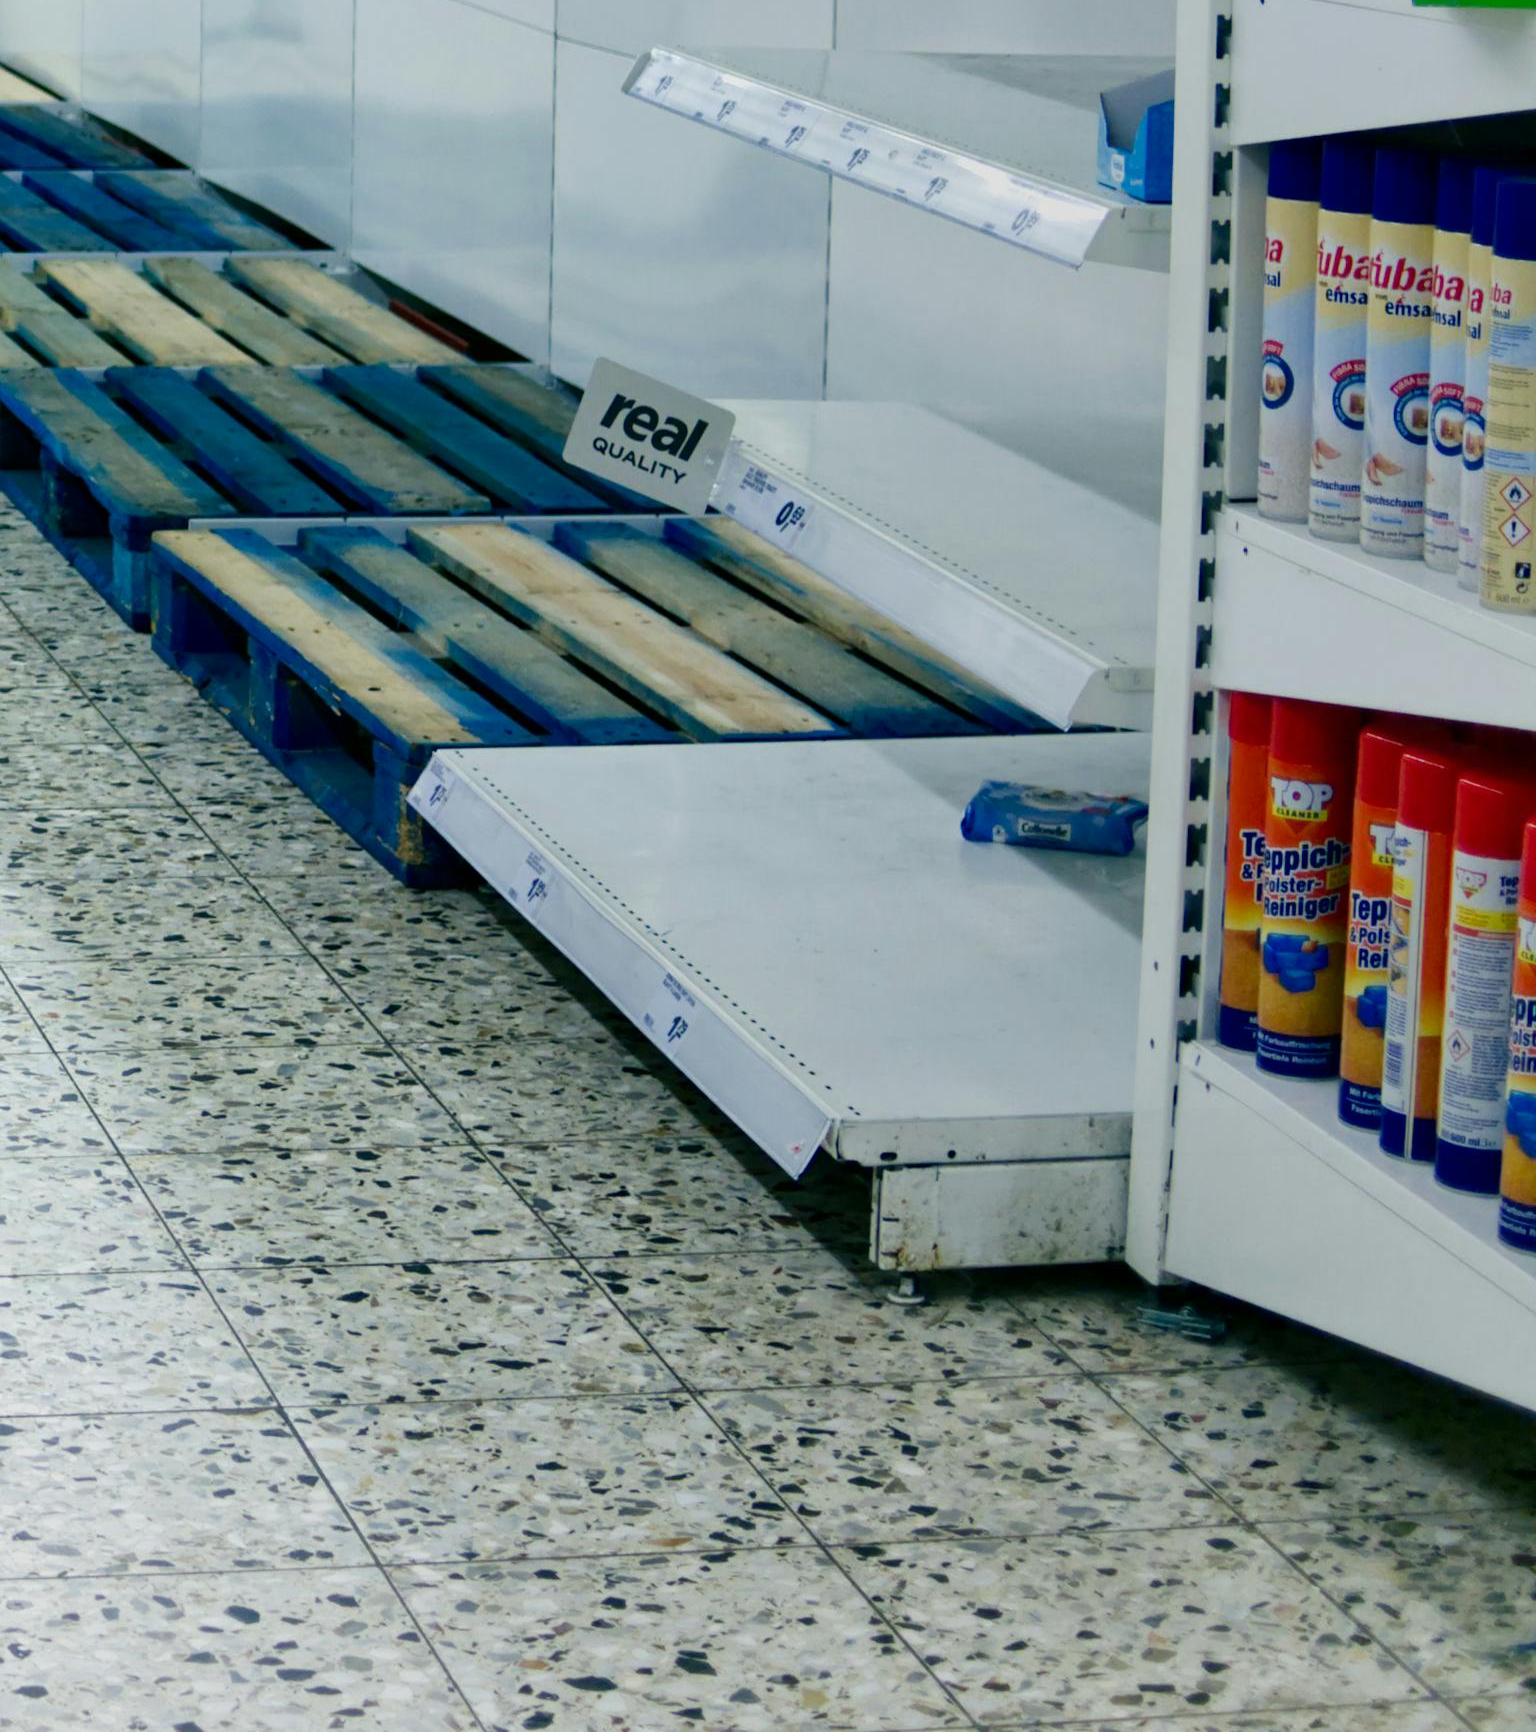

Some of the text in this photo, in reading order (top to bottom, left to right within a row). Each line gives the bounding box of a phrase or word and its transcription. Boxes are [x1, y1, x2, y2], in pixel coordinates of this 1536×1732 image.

[600, 393, 709, 462] real
[592, 436, 687, 485] QUALITY
[1271, 777, 1333, 810] TOP
[1021, 822, 1068, 837] Cottonelle
[1276, 808, 1319, 819] CLEANER
